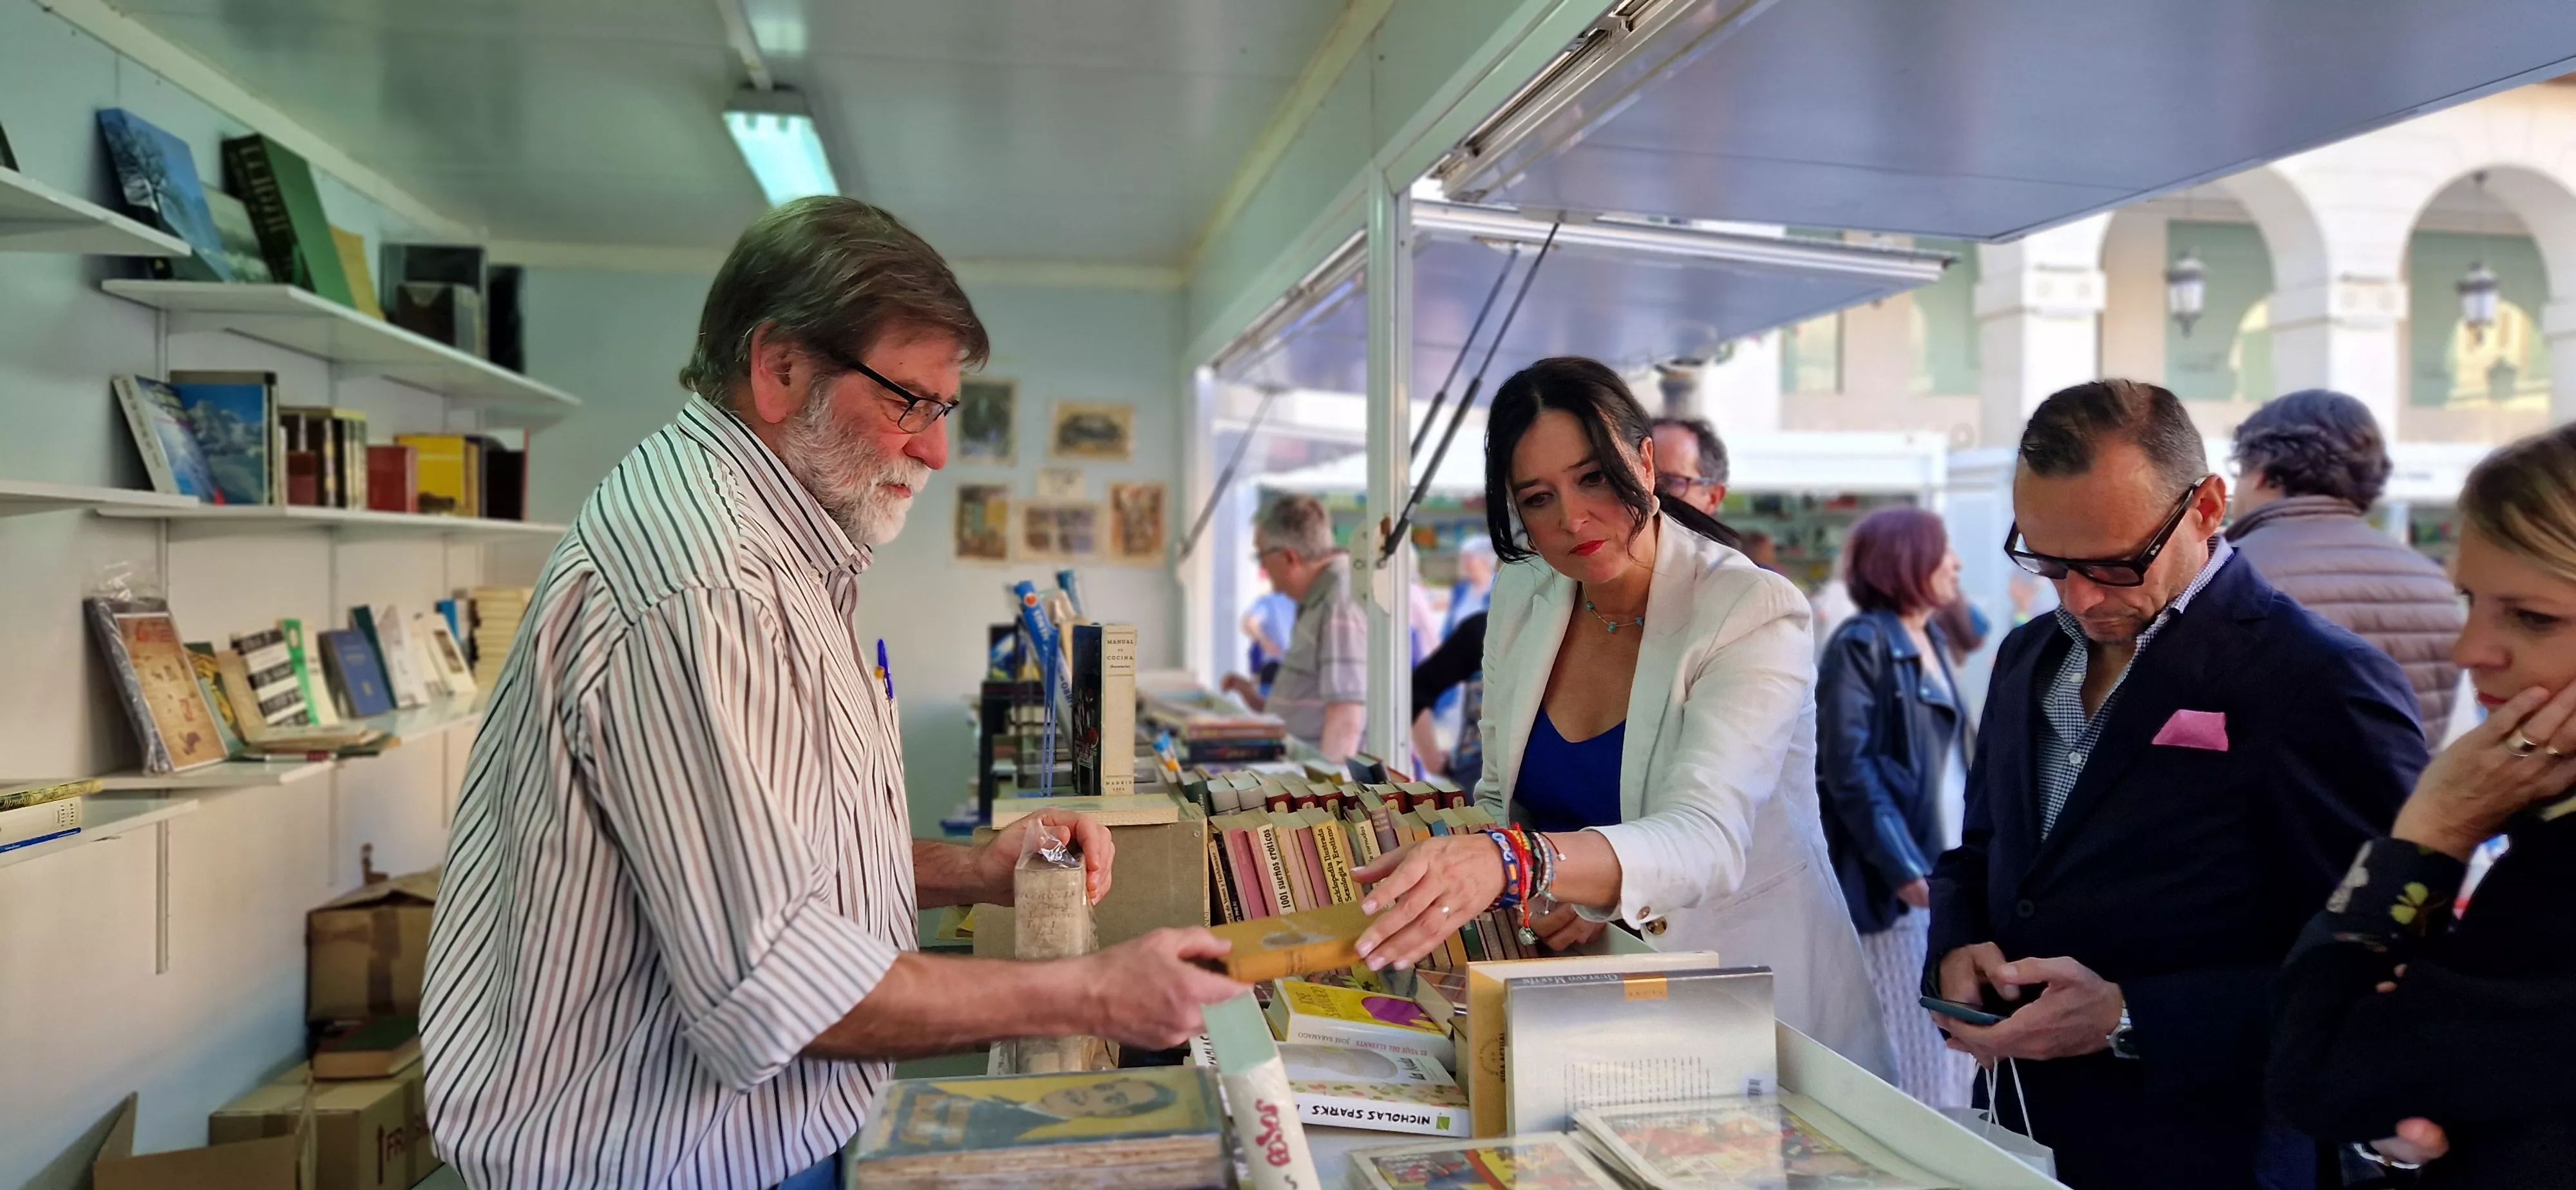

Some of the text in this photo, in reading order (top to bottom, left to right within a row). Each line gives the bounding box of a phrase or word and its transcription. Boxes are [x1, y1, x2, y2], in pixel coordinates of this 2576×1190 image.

[1263, 829, 1278, 861] eróticos
[1327, 826, 1340, 859] Erotismo
[1360, 826, 1372, 855] cornudos
[1272, 862, 1286, 890] sueños
[1318, 828, 1344, 904] nciclopedia Ilustrada
[1339, 865, 1352, 902] Sexología
[1280, 891, 1291, 909] 1001
[1522, 973, 1618, 985] GUSTAVO MARTÍN
[1297, 1032, 1334, 1043] SARAMAGO
[1356, 1040, 1387, 1050] ELEFANTE
[1400, 1048, 1419, 1056] VIAJE
[1311, 1104, 1430, 1124] NICHOLAS SPARKS
